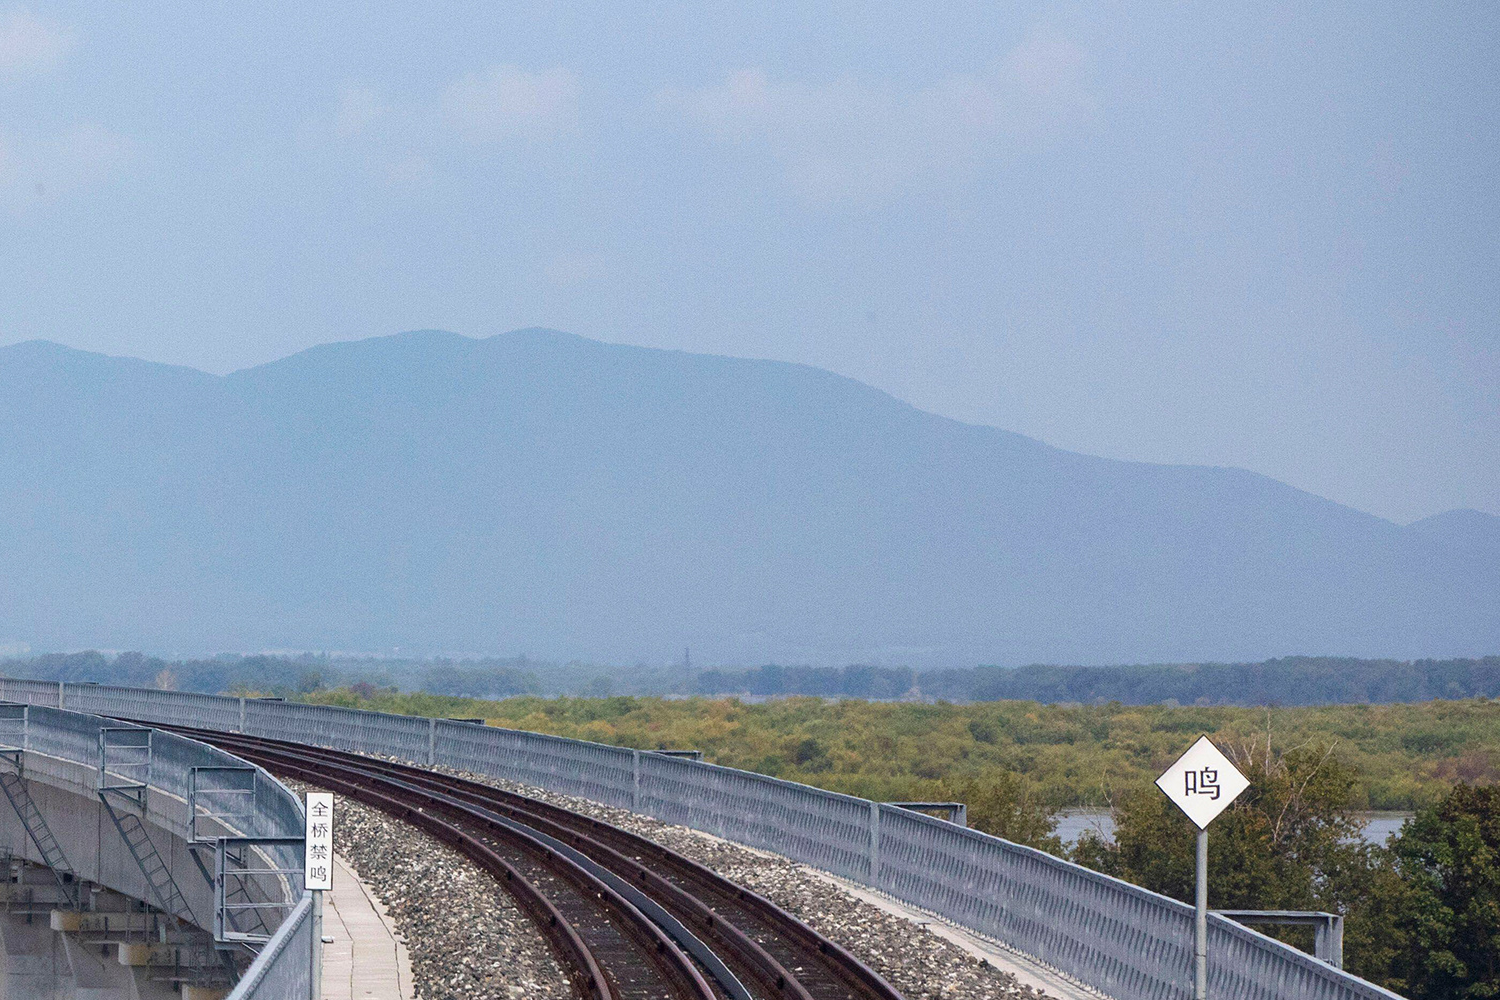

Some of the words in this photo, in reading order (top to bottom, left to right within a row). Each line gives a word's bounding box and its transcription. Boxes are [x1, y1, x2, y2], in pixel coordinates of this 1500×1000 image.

[1184, 766, 1220, 800] 鸣
[310, 801, 328, 882] 全桥禁鸣
